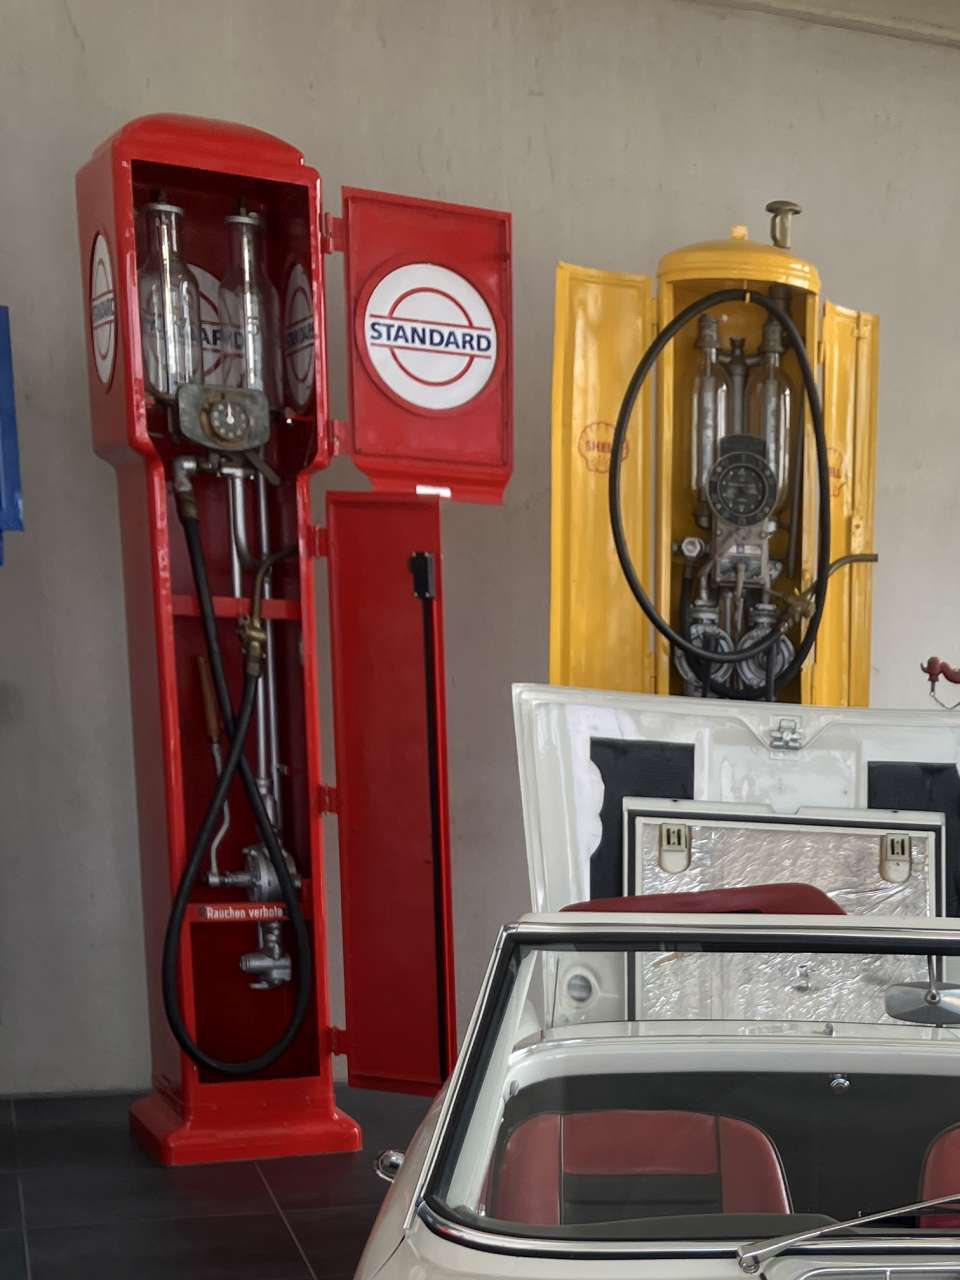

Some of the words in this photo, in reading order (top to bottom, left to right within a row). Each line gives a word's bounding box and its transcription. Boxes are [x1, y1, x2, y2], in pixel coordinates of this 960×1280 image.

[370, 321, 492, 352] STANDARD
[206, 906, 246, 920] Rauchen
[248, 905, 284, 919] verbote
